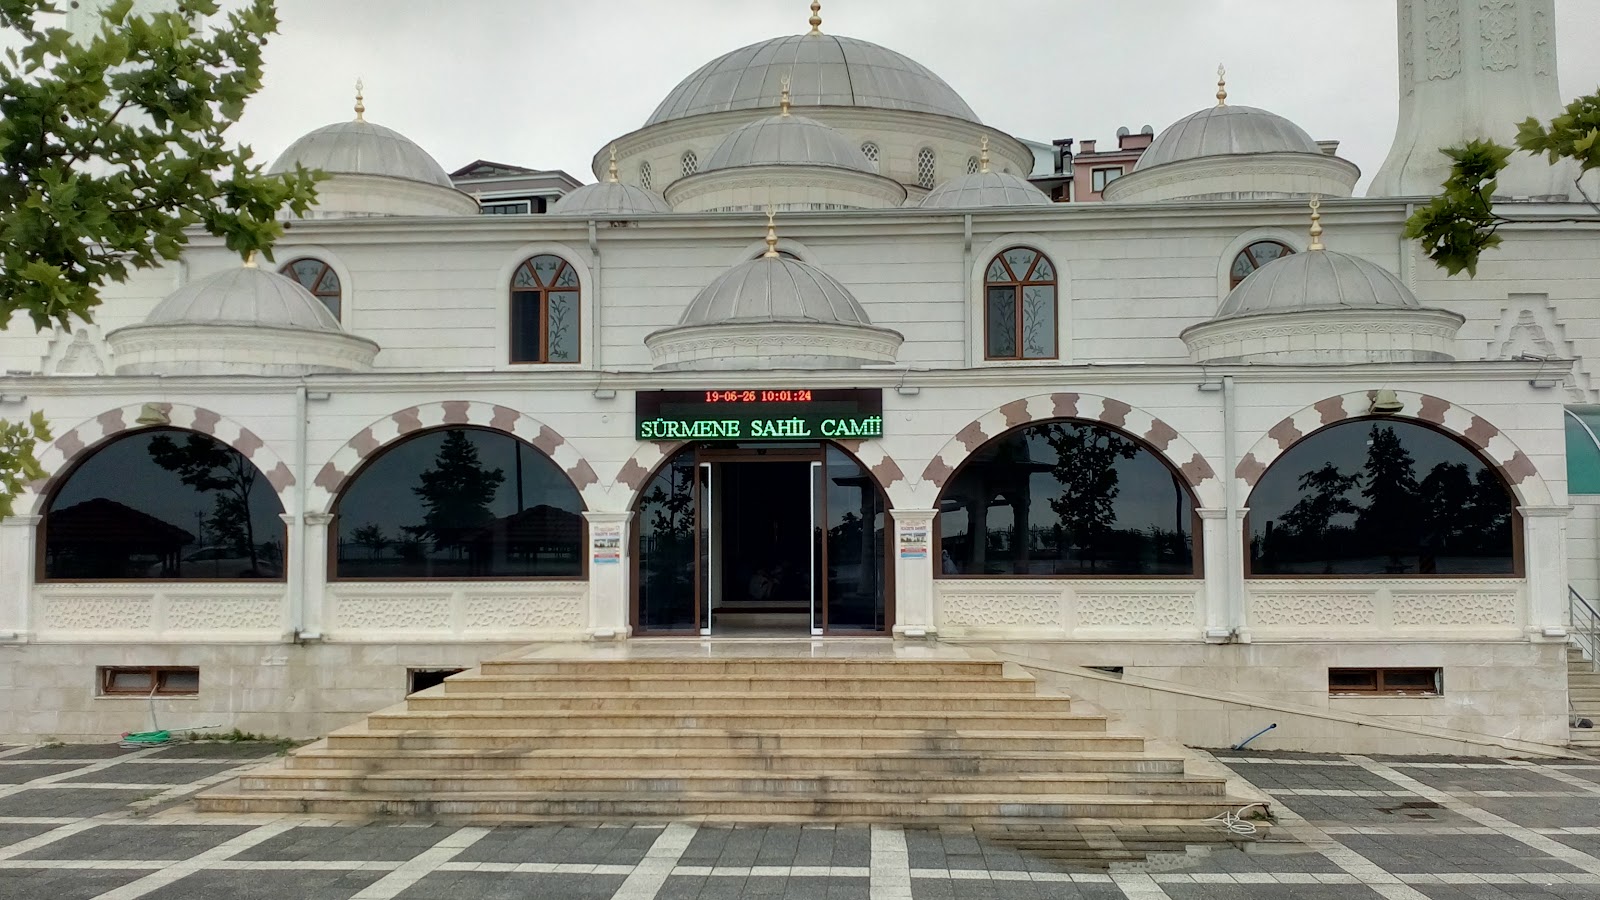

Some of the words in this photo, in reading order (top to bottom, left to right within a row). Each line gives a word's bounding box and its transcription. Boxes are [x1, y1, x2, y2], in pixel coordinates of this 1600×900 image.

[705, 390, 756, 402] 19-06-26
[761, 390, 812, 401] 10:01:24
[641, 417, 740, 438] SÜRMENE
[750, 416, 811, 437] SAHİL
[820, 415, 882, 436] CAMİİ
